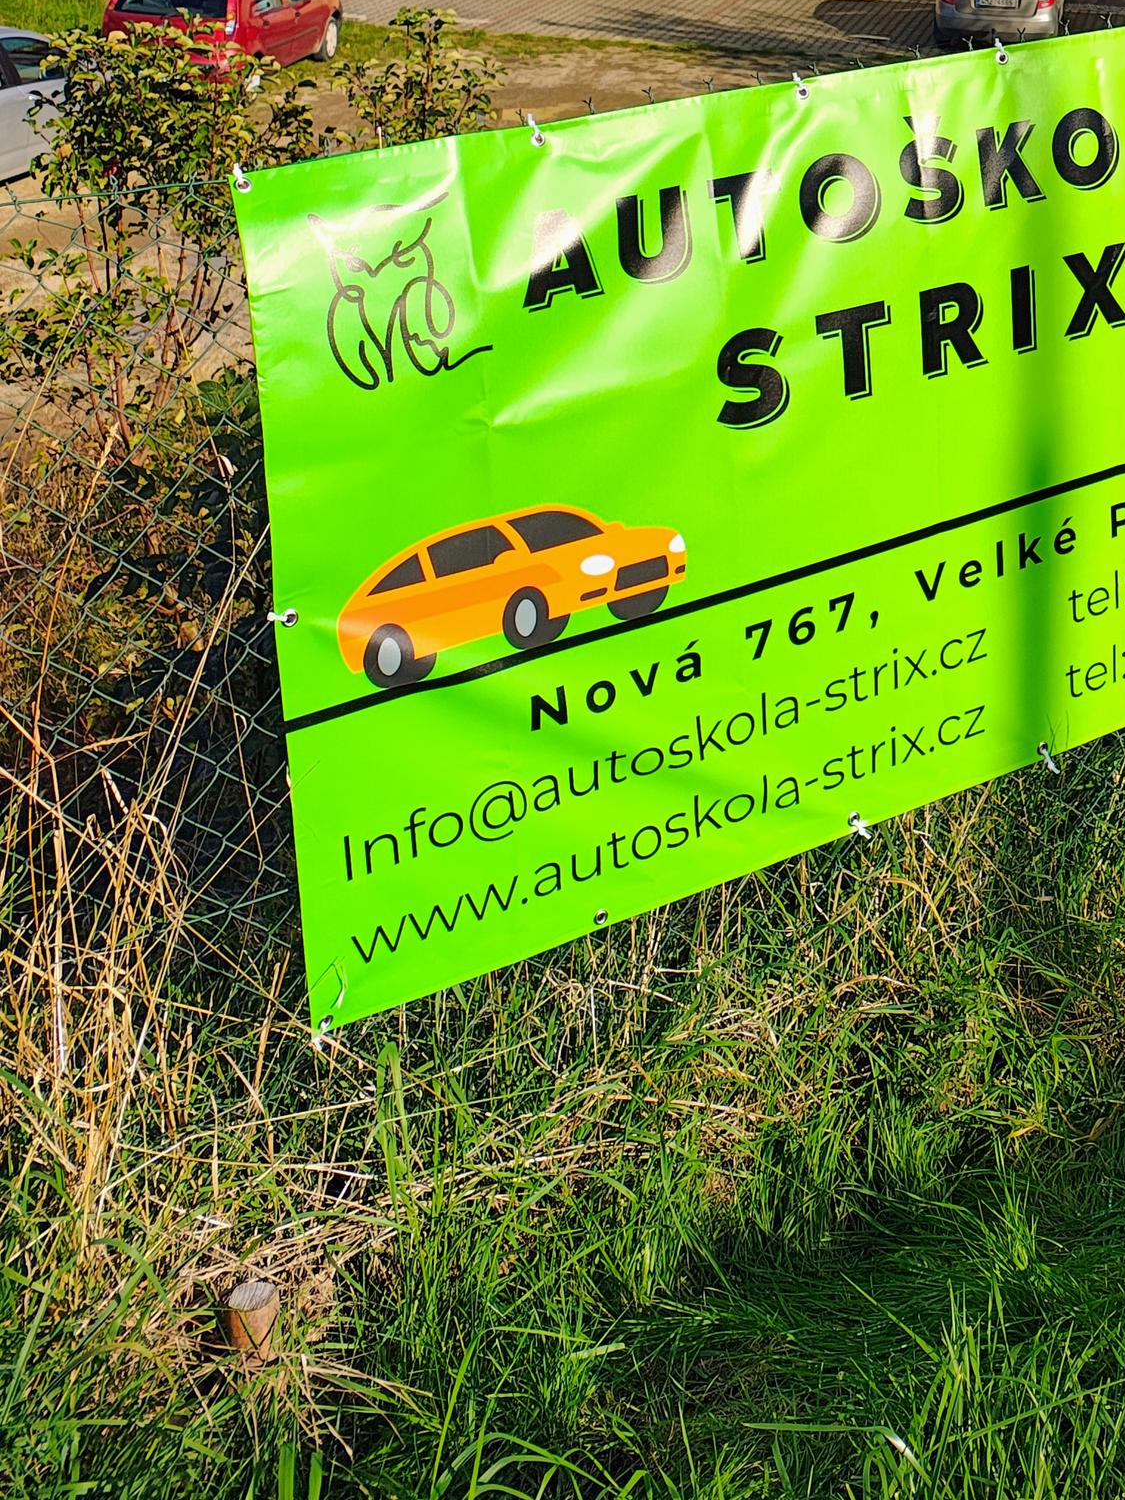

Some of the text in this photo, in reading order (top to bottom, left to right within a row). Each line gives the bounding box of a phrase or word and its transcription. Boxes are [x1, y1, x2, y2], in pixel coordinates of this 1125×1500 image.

[530, 639, 703, 732] Nová
[745, 592, 880, 661] 767,
[914, 516, 1077, 602] Velké
[341, 626, 989, 882] Info@autoskola-strix.cz
[350, 703, 987, 965] www.autoskola-strix.cz
